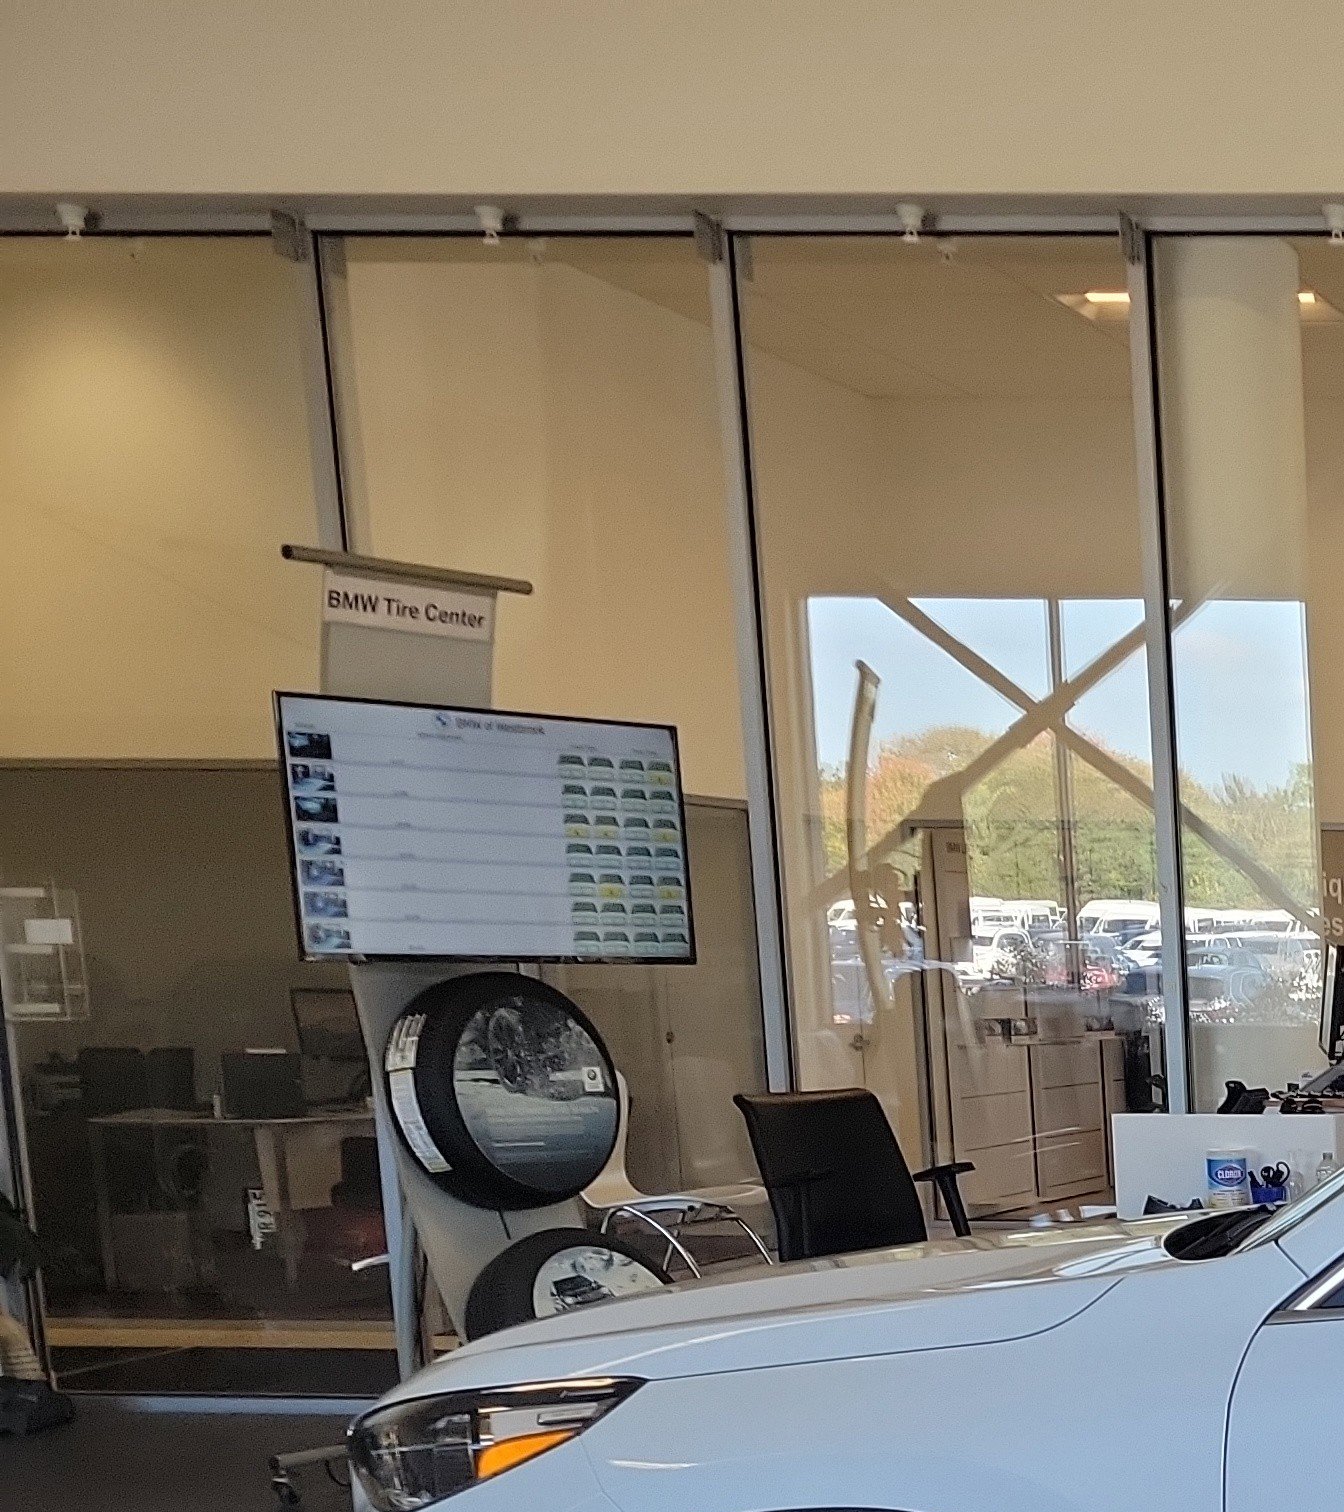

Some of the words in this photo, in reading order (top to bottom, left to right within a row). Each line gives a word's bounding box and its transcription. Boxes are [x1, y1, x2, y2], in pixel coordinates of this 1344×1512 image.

[327, 589, 379, 614] BMW
[383, 597, 420, 619] Tire
[424, 603, 486, 628] Center
